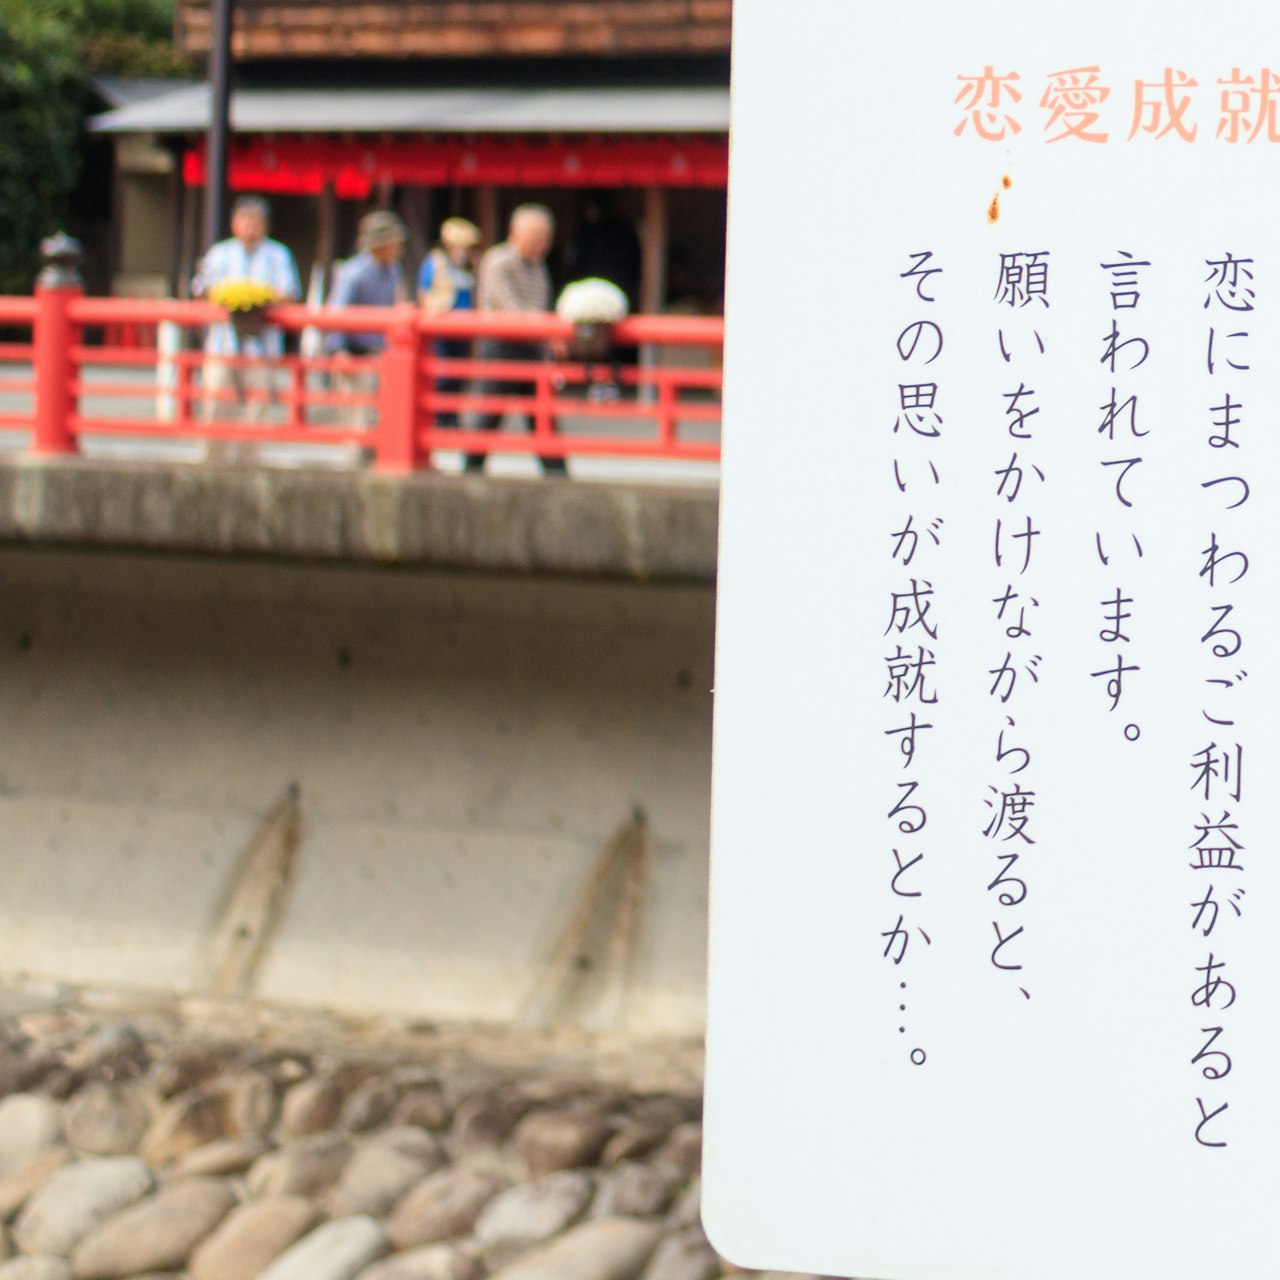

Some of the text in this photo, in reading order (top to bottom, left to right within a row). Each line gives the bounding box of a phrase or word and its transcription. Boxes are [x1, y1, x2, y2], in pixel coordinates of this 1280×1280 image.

[981, 250, 1051, 1001] 願いをかけながら渡ると、
[1089, 250, 1152, 742] 言われています。
[1188, 251, 1256, 1148] 恋にまつわるご利益があると
